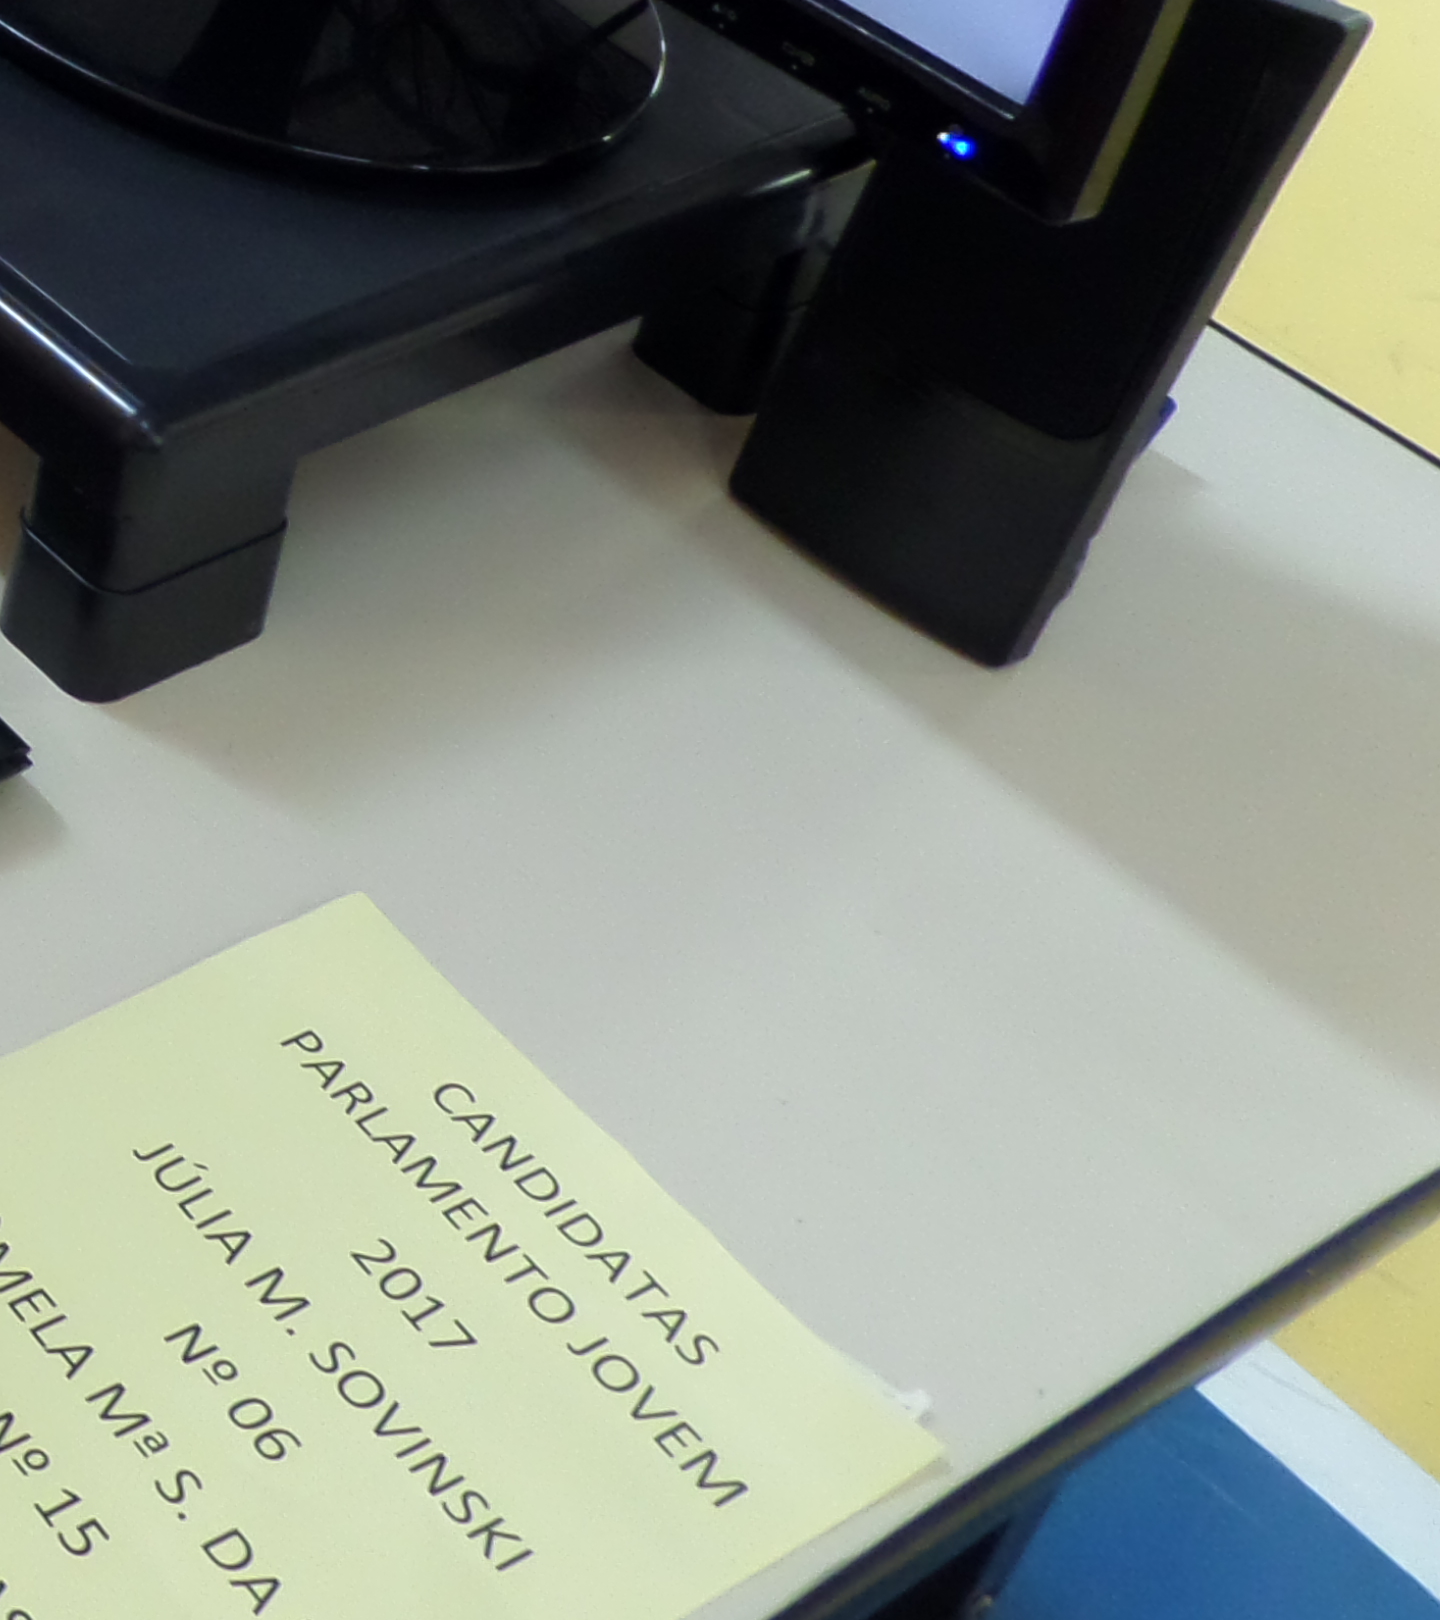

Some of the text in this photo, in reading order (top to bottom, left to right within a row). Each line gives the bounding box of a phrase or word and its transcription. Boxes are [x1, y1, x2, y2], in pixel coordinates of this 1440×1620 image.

[280, 1030, 748, 1507] PARLAMENTO JOVEM
[350, 1239, 477, 1347] 2017
[434, 1083, 719, 1365] CANDIDATAS
[133, 1143, 533, 1571] JÚLIA M. SOVINSKI
[164, 1324, 302, 1460] Nº 06
[34, 1489, 109, 1556] 15
[85, 1383, 169, 1458] Mª
[155, 1470, 202, 1520] S.
[201, 1528, 281, 1616] DA
